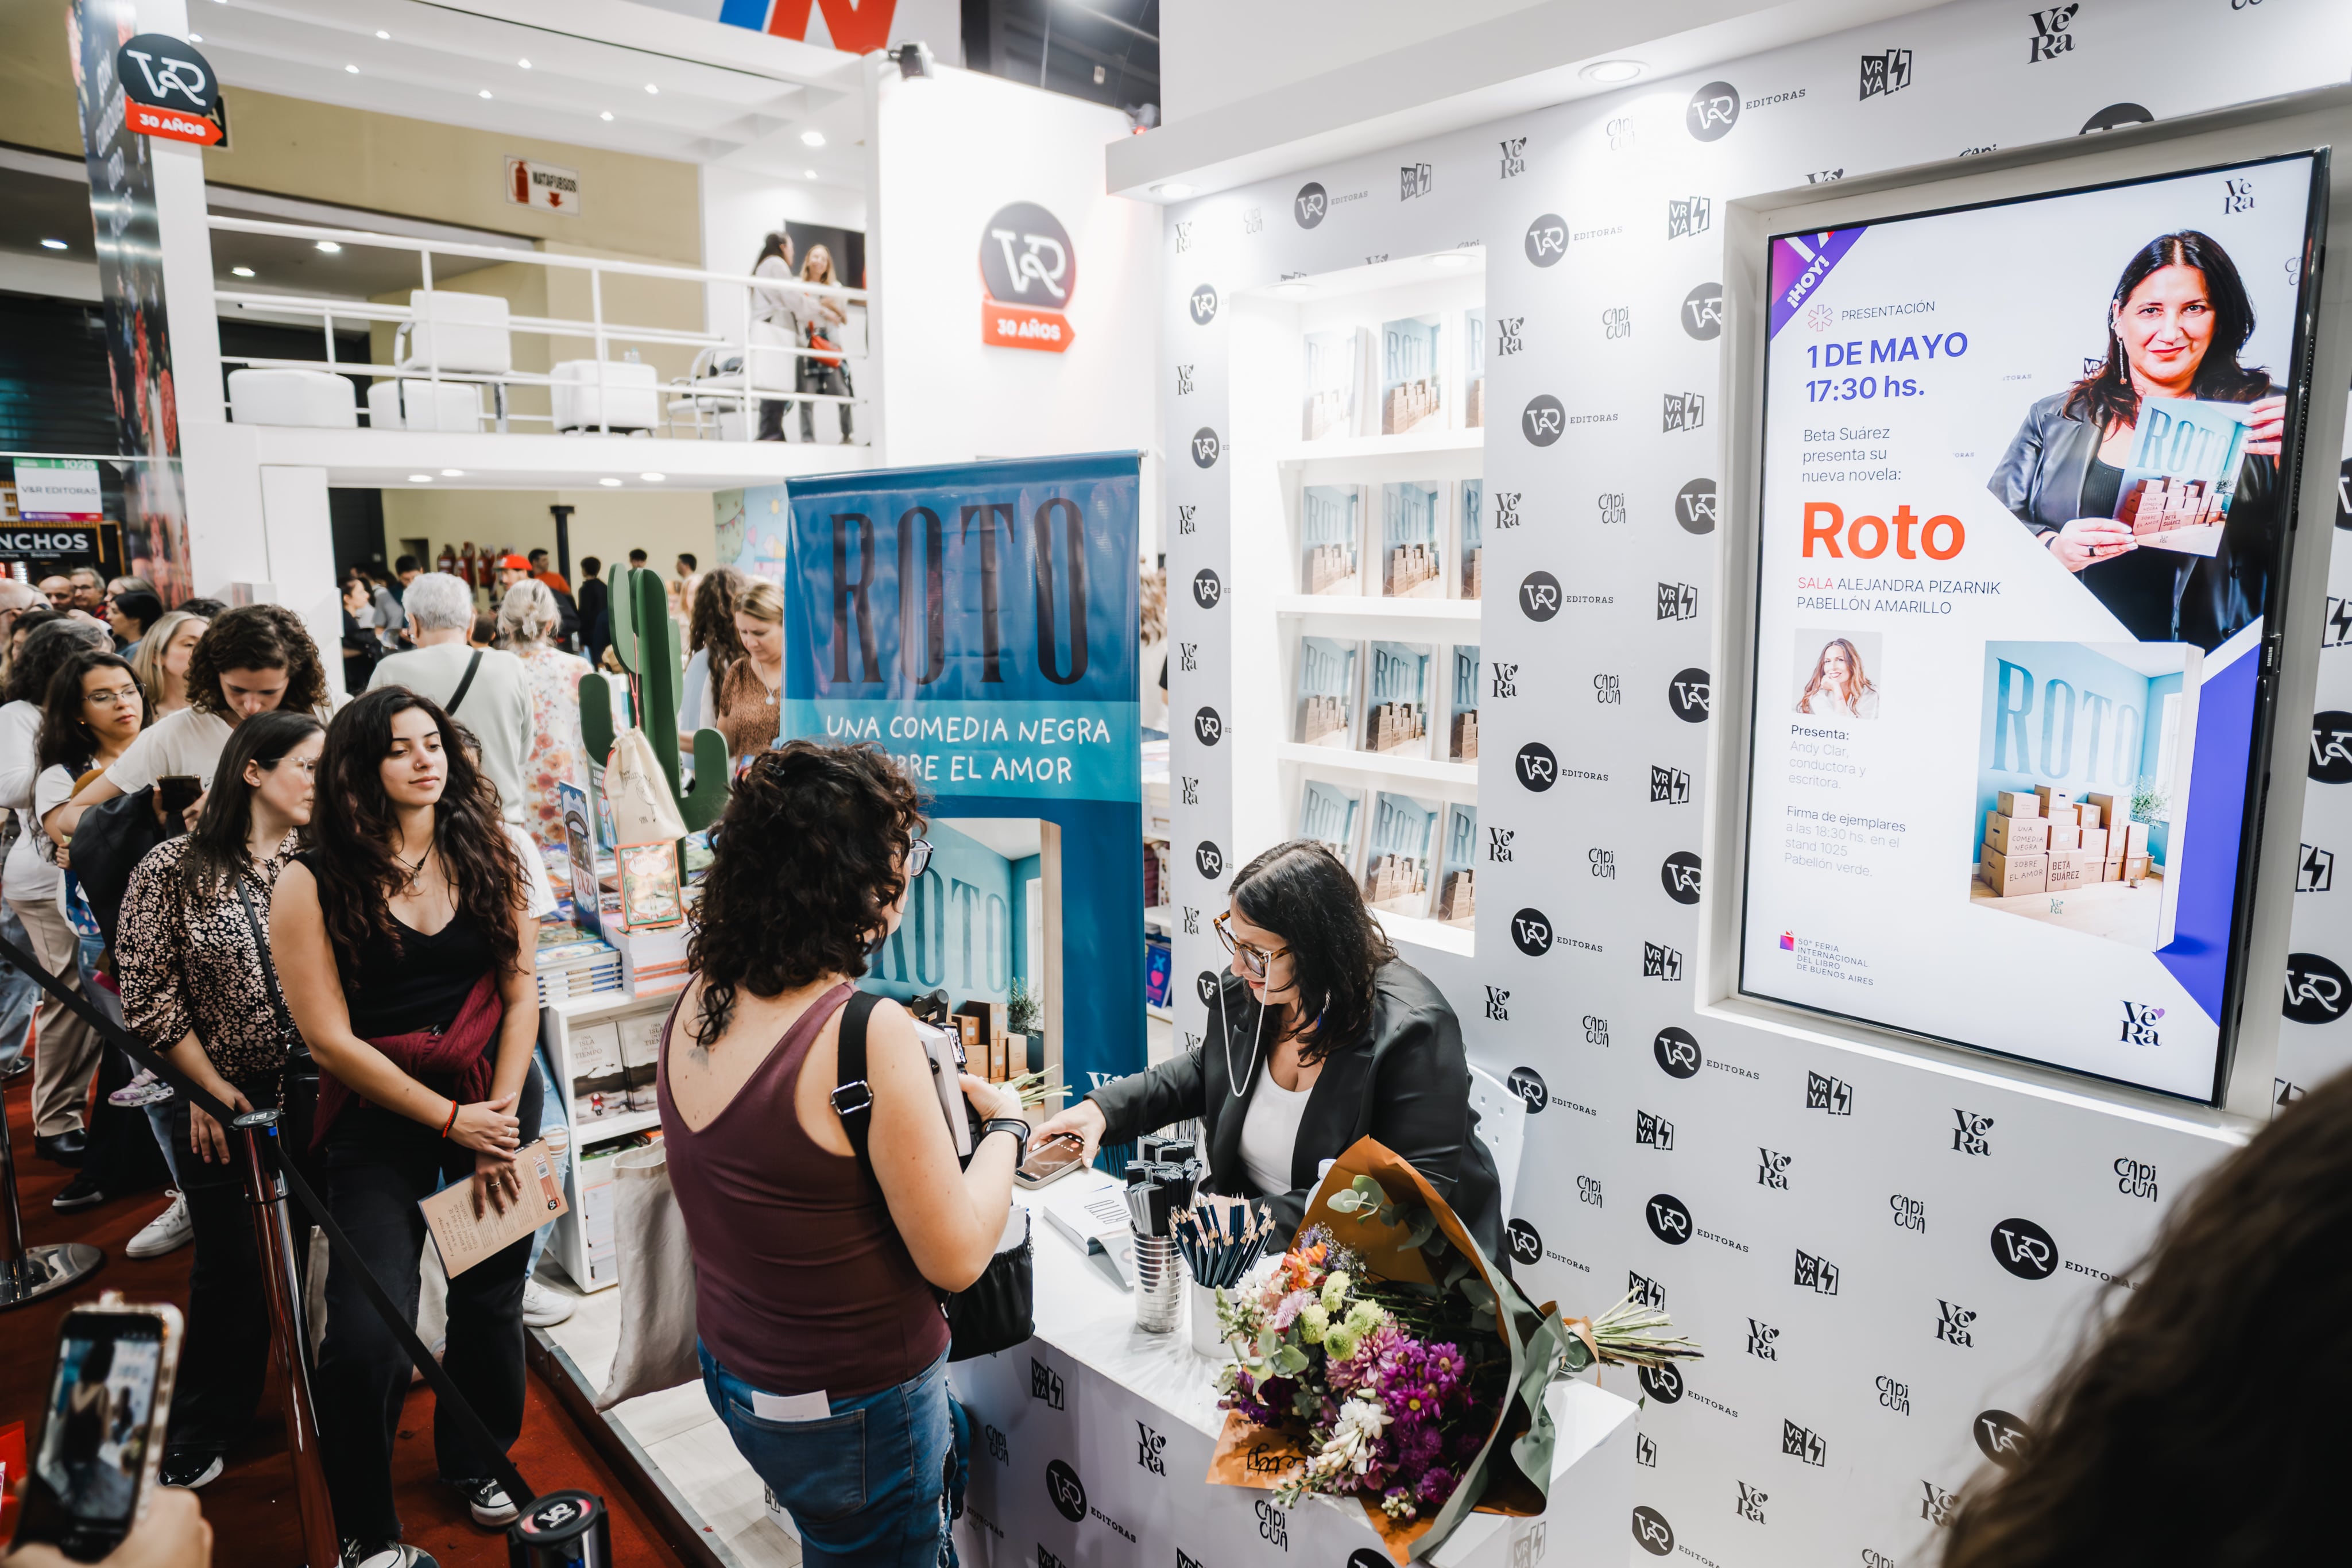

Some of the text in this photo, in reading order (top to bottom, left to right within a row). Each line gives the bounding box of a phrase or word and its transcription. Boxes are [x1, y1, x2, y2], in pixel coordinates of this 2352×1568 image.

[1863, 60, 1883, 75] VR
[1863, 76, 1883, 95] YA
[1746, 88, 1805, 109] EDITORAS
[140, 113, 206, 137] 30 AÑOS
[533, 172, 577, 192] MATAFUEGOS
[1402, 171, 1414, 183] VR
[1331, 191, 1368, 205] EDITORAS
[1402, 183, 1415, 197] YA
[1787, 255, 1830, 308] ¡HOY!
[1842, 301, 1935, 320] PRESENTACIÓN
[997, 319, 1061, 340] 30 AÑOS
[1808, 332, 1967, 368] 1 DE MAYO
[1806, 375, 1924, 402] 17:30 hs.
[1665, 398, 1681, 412] VR
[1570, 414, 1618, 424] EDITORAS
[1665, 413, 1682, 429] YA
[1804, 427, 1890, 442] Beta Suárez
[2137, 406, 2229, 477] ROTO
[1803, 449, 1886, 465] presenta su
[1802, 467, 1901, 482] nueva novela:
[45, 486, 97, 495] EDITORAS
[1387, 491, 1429, 540] ROTO
[1802, 502, 1965, 560] Roto
[830, 498, 1088, 685] ROTO
[1798, 577, 2001, 594] SALA ALEJANDRA PIZARNIK
[1797, 595, 1951, 614] PABELLÓN AMARILLO
[1374, 648, 1419, 700] ROTO
[827, 715, 1110, 745] UNA COMEDIA NEGRA
[1990, 657, 2140, 788] ROTO
[1792, 725, 1848, 740] Presenta:
[1790, 741, 1850, 758] Andy Clar,
[950, 756, 981, 781] EL
[991, 757, 1071, 784] AMOR
[1562, 769, 1608, 781] EDITORAS
[1653, 769, 1668, 784] VR
[1789, 758, 1866, 777] conductora y
[1789, 773, 1842, 789] escritora.
[1653, 785, 1669, 799] YA
[1304, 788, 1346, 841] ROTO
[1787, 806, 1906, 833] Firma de ejemplares
[1376, 799, 1425, 854] ROTO
[1786, 823, 1900, 848] a las 18:30 hs. en el
[1785, 837, 1848, 857] stand 1025
[1785, 852, 1873, 877] Pabellón verde.
[2021, 869, 2043, 879] AMOR
[2052, 861, 2071, 870] BETA
[1557, 936, 1603, 952] EDITORAS
[1646, 946, 1661, 961] VR
[1815, 941, 1839, 953] FERIA
[1797, 947, 1869, 968] INTERNACIONAL
[1797, 955, 1840, 970] DEL LIBRO
[1646, 961, 1661, 974] YA
[1810, 966, 1845, 979] BUENOS
[1848, 974, 1874, 986] AIRES
[579, 1039, 595, 1047] ISLA
[575, 1049, 602, 1059] TIEMPO
[1707, 1059, 1759, 1079] EDITORAS
[1810, 1075, 1827, 1093] VR
[1552, 1097, 1596, 1116] EDITORAS
[1809, 1091, 1827, 1106] YA
[457, 1230, 466, 1245] ROMPE
[462, 1229, 473, 1250] SOSTIENE
[469, 1231, 478, 1249] TIEMPO
[1697, 1229, 1748, 1252] EDITORAS
[1546, 1250, 1589, 1272] EDITORAS
[1688, 1390, 1738, 1418] EDITORAS
[1090, 1507, 1136, 1543] EDITORAS
